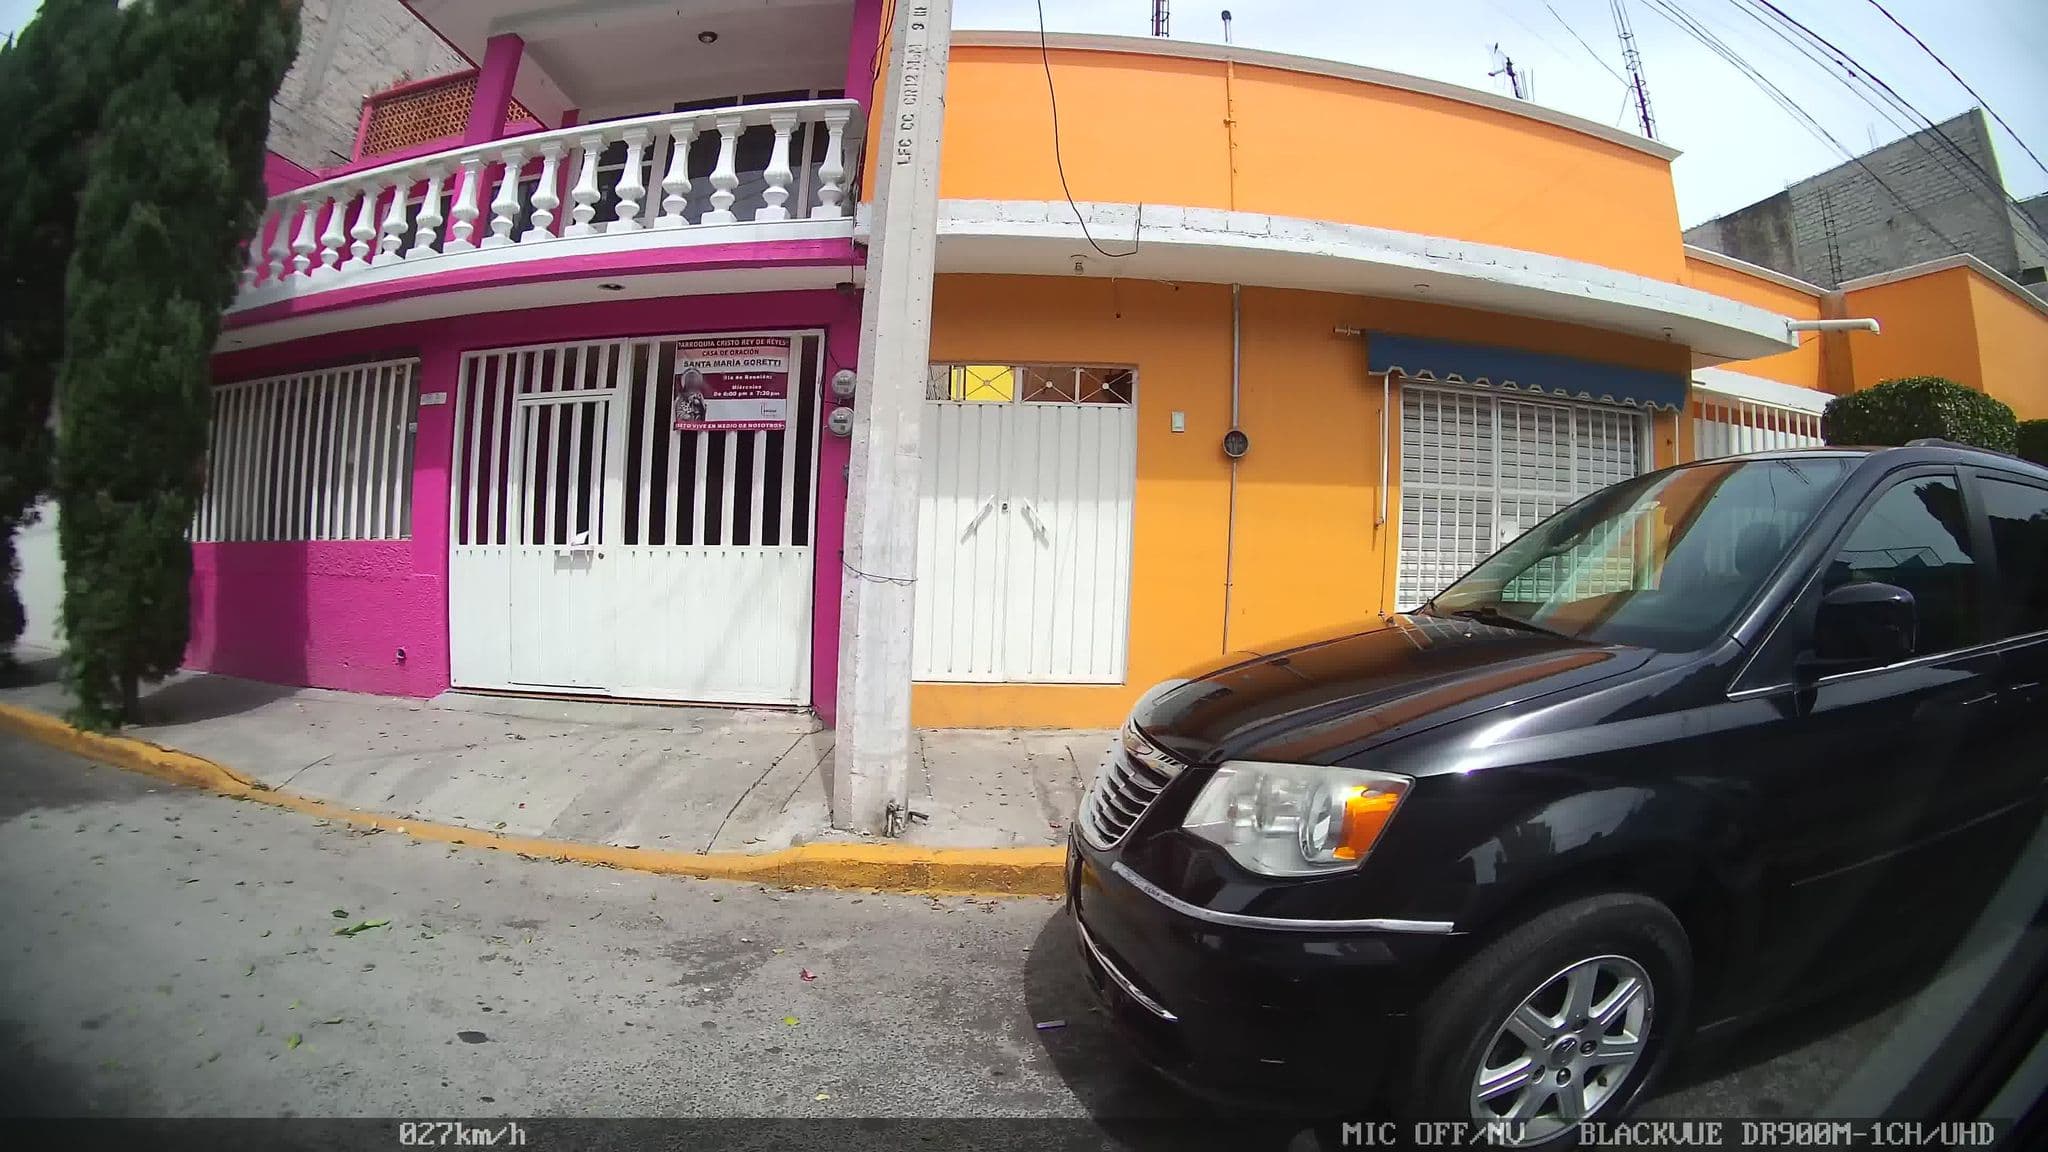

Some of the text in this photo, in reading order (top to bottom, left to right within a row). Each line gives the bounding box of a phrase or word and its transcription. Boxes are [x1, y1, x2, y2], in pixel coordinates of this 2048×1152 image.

[716, 339, 740, 347] CRISTO
[741, 338, 755, 346] REY
[729, 348, 760, 356] ORACIÓN
[683, 358, 781, 368] SANTA MARÍA GORETTI
